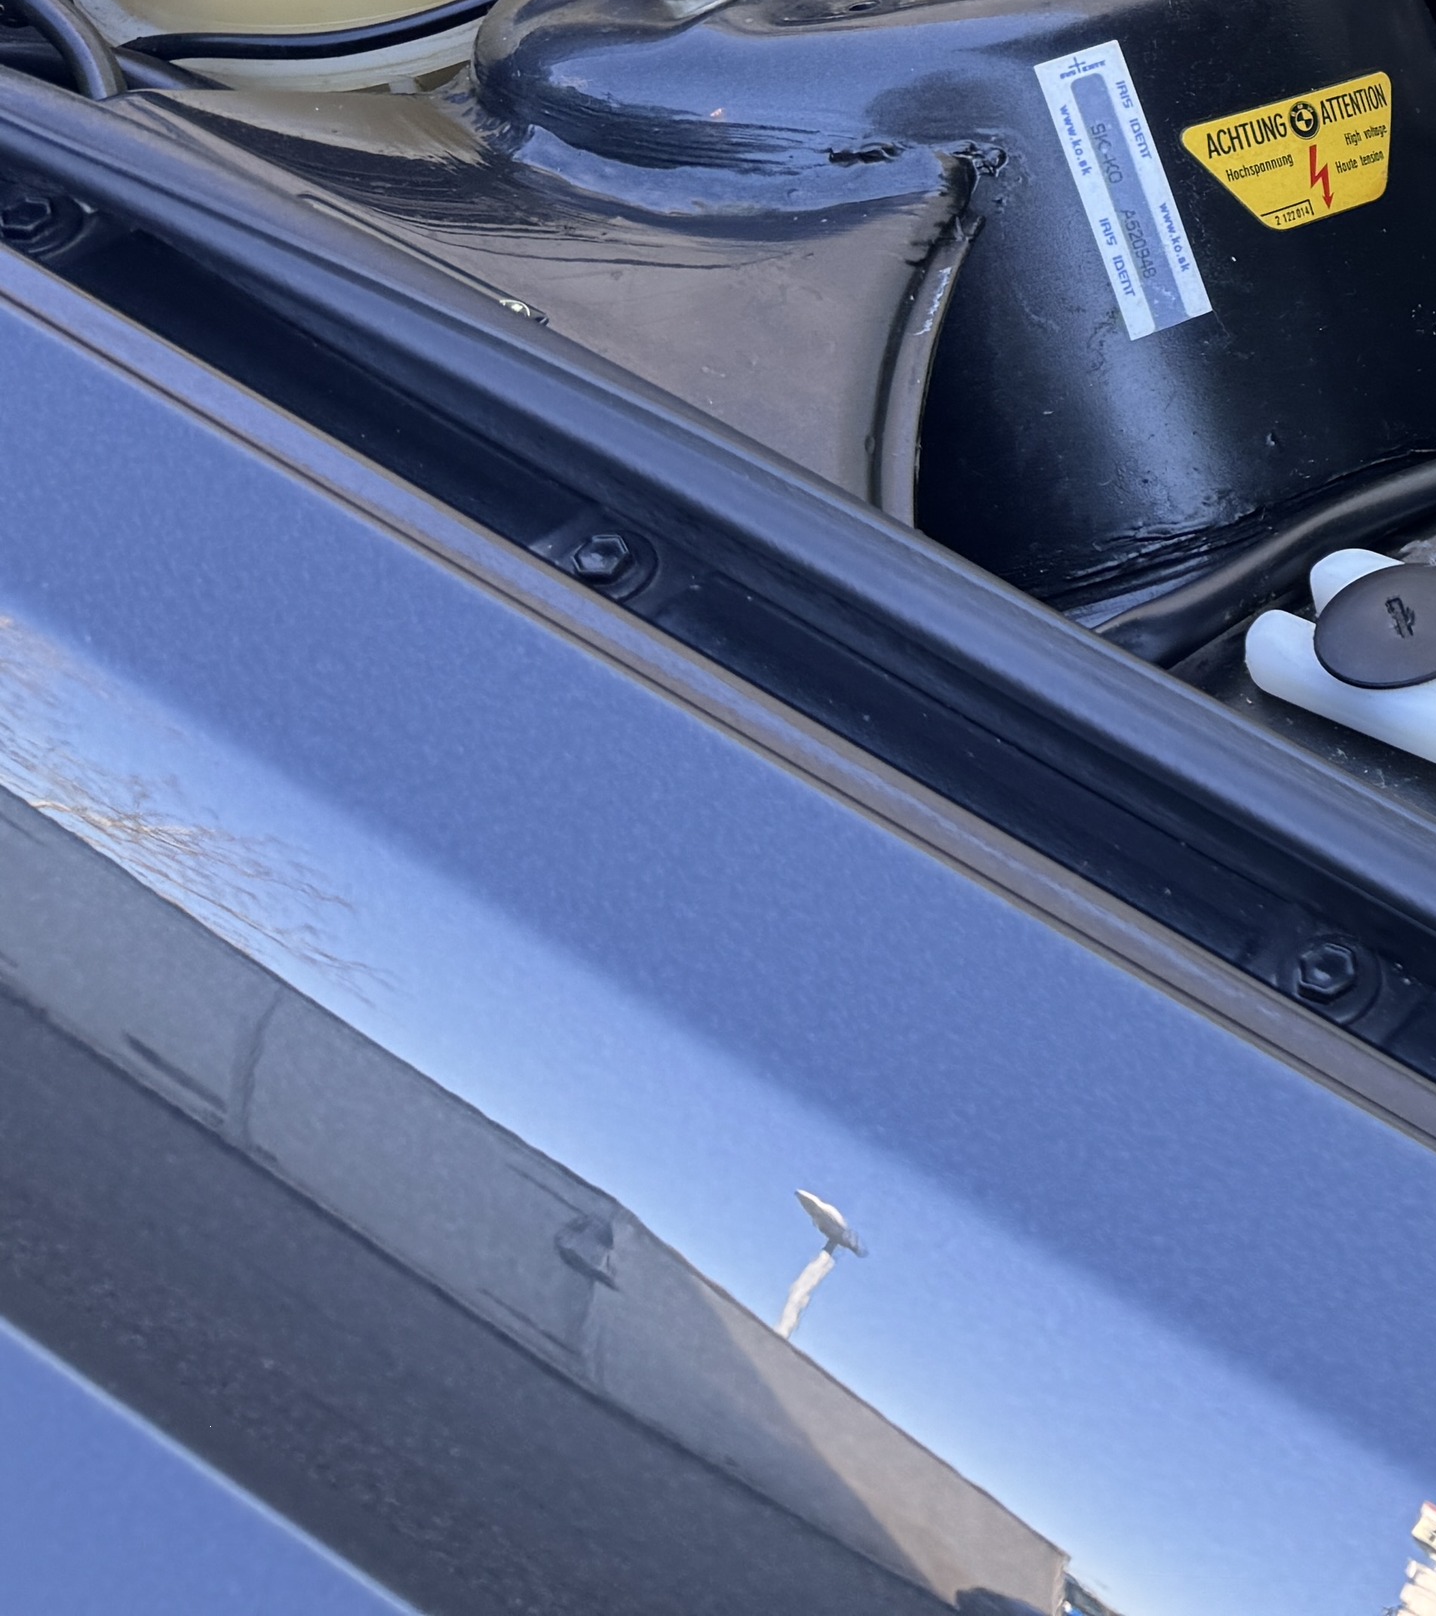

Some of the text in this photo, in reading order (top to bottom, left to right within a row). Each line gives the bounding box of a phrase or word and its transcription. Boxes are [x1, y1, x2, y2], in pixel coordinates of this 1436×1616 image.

[1115, 80, 1152, 159] IRIS IDENT
[1206, 83, 1388, 159] ACHTUNG ATTENTION
[1344, 124, 1388, 146] High voltage
[1225, 154, 1294, 182] Hochspannung
[1359, 150, 1385, 166] tension
[1099, 217, 1136, 297] IRIS IDENT
